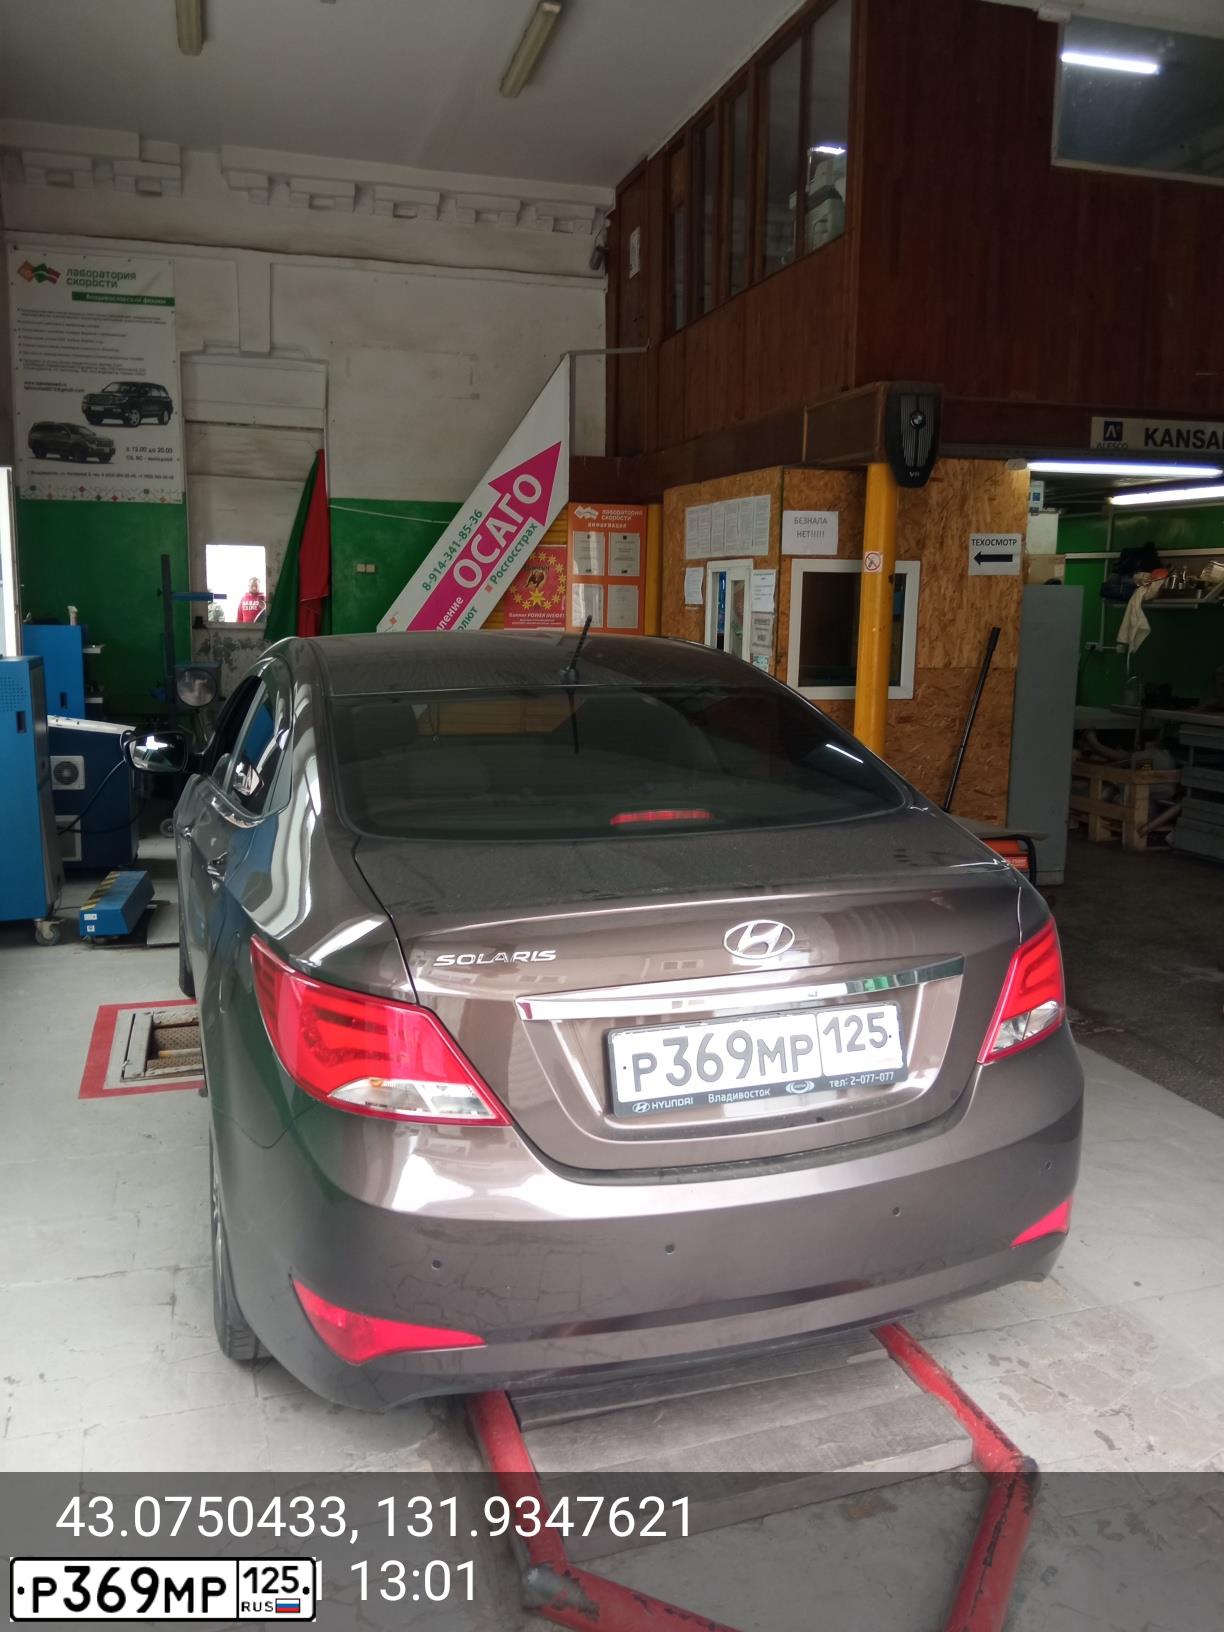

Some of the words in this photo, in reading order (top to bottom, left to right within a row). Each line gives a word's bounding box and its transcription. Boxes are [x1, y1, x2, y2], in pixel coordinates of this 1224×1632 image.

[1144, 427, 1224, 450] KANSA
[794, 516, 828, 525] БЕЗНАЛА
[453, 474, 542, 589] ОСАГО
[422, 509, 483, 592] 8-914-341-85-36
[971, 537, 1018, 547] ТЕХОСМОТР
[491, 523, 538, 585] Росгосстрах
[433, 950, 557, 967] SOLARIS
[631, 1029, 814, 1092] Р369МР
[822, 1011, 888, 1054] 125
[849, 1071, 894, 1086] 2-077-077
[651, 1097, 694, 1110] HYUNDAI
[708, 1087, 771, 1103] Владивосток
